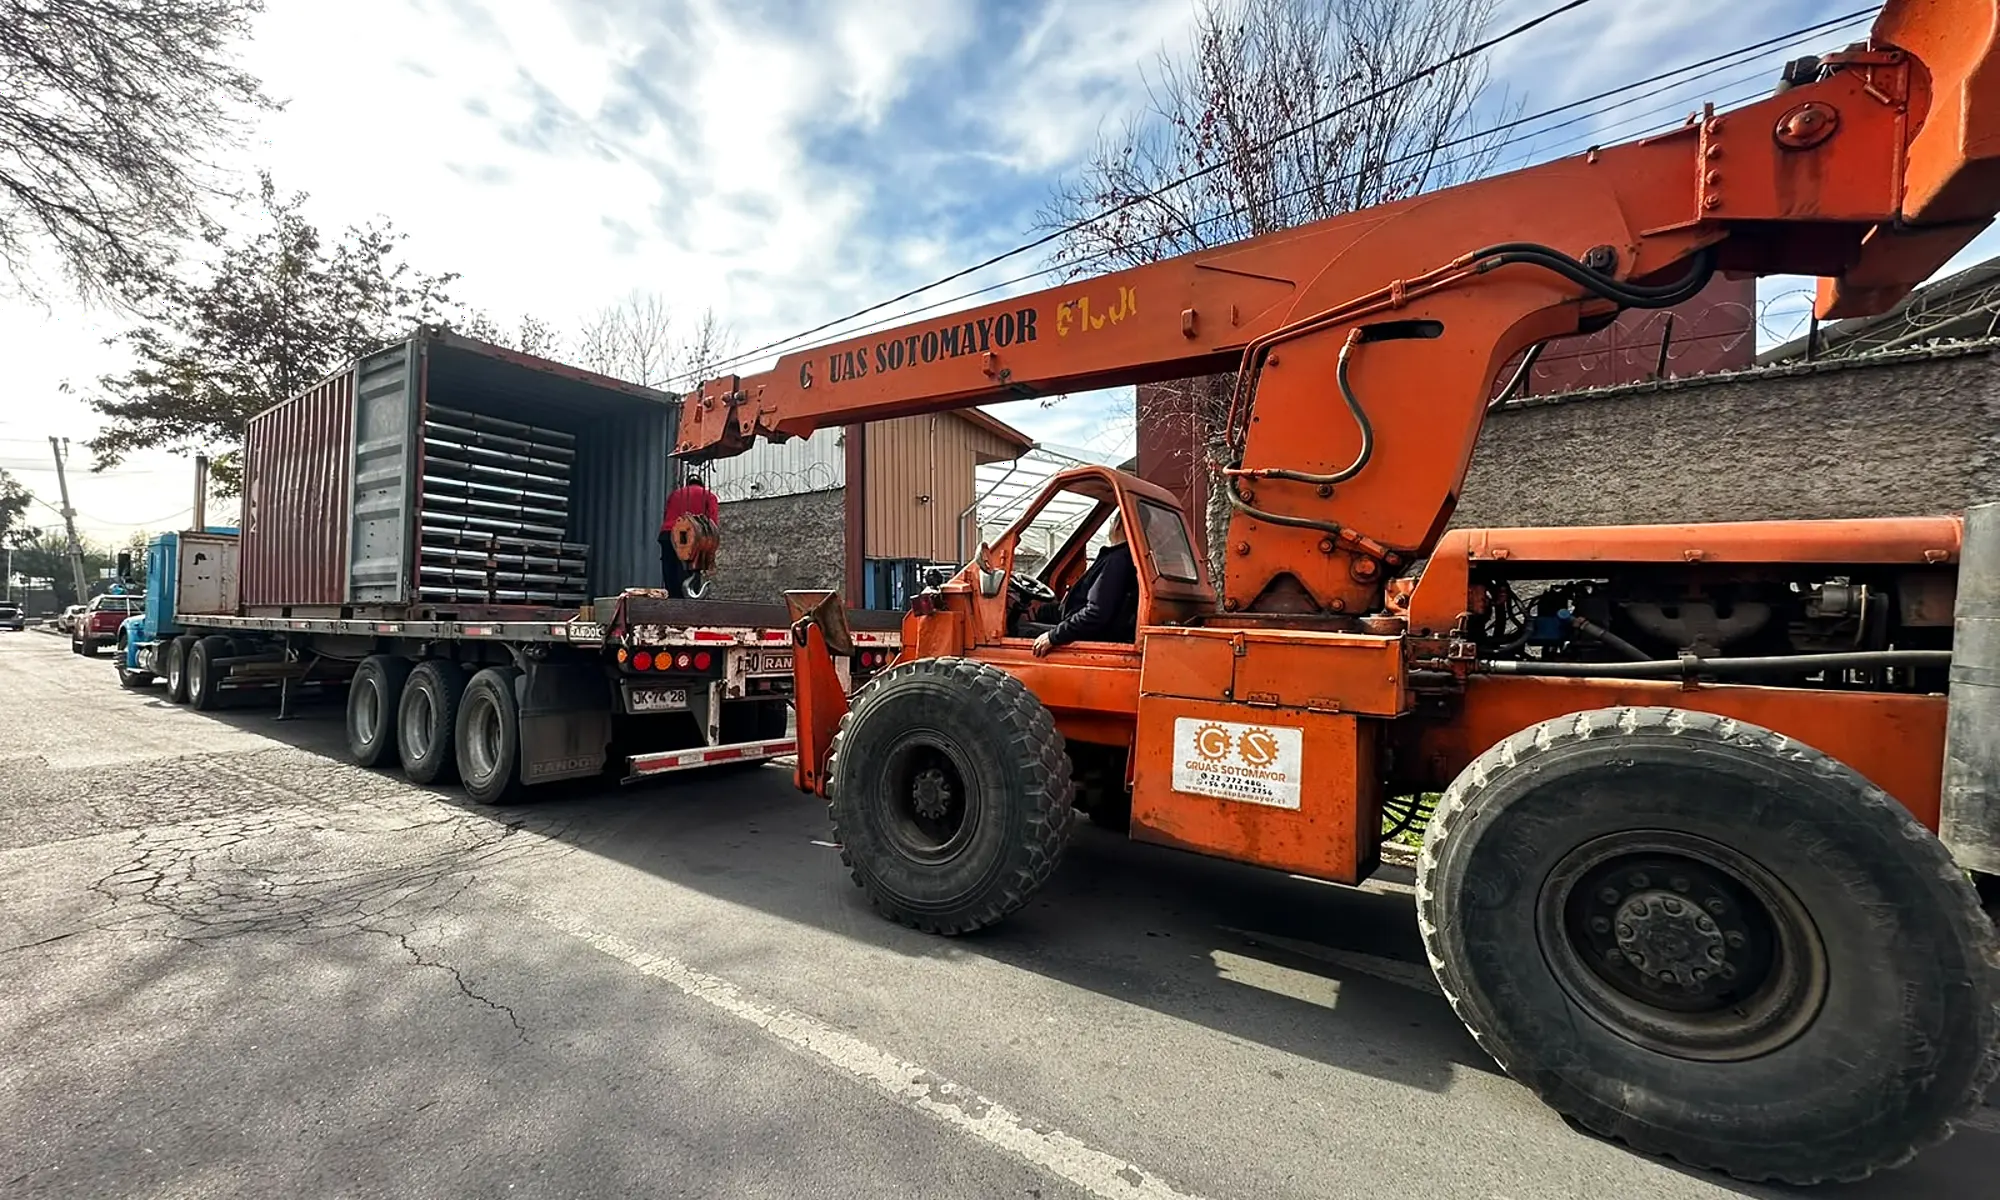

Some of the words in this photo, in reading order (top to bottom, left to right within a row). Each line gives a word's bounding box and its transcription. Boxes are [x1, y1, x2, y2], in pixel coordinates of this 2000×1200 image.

[876, 308, 1038, 375] SOTOMAYOR
[1185, 760, 1218, 773] GRUAS
[1221, 765, 1286, 782] SOTOMAYOR
